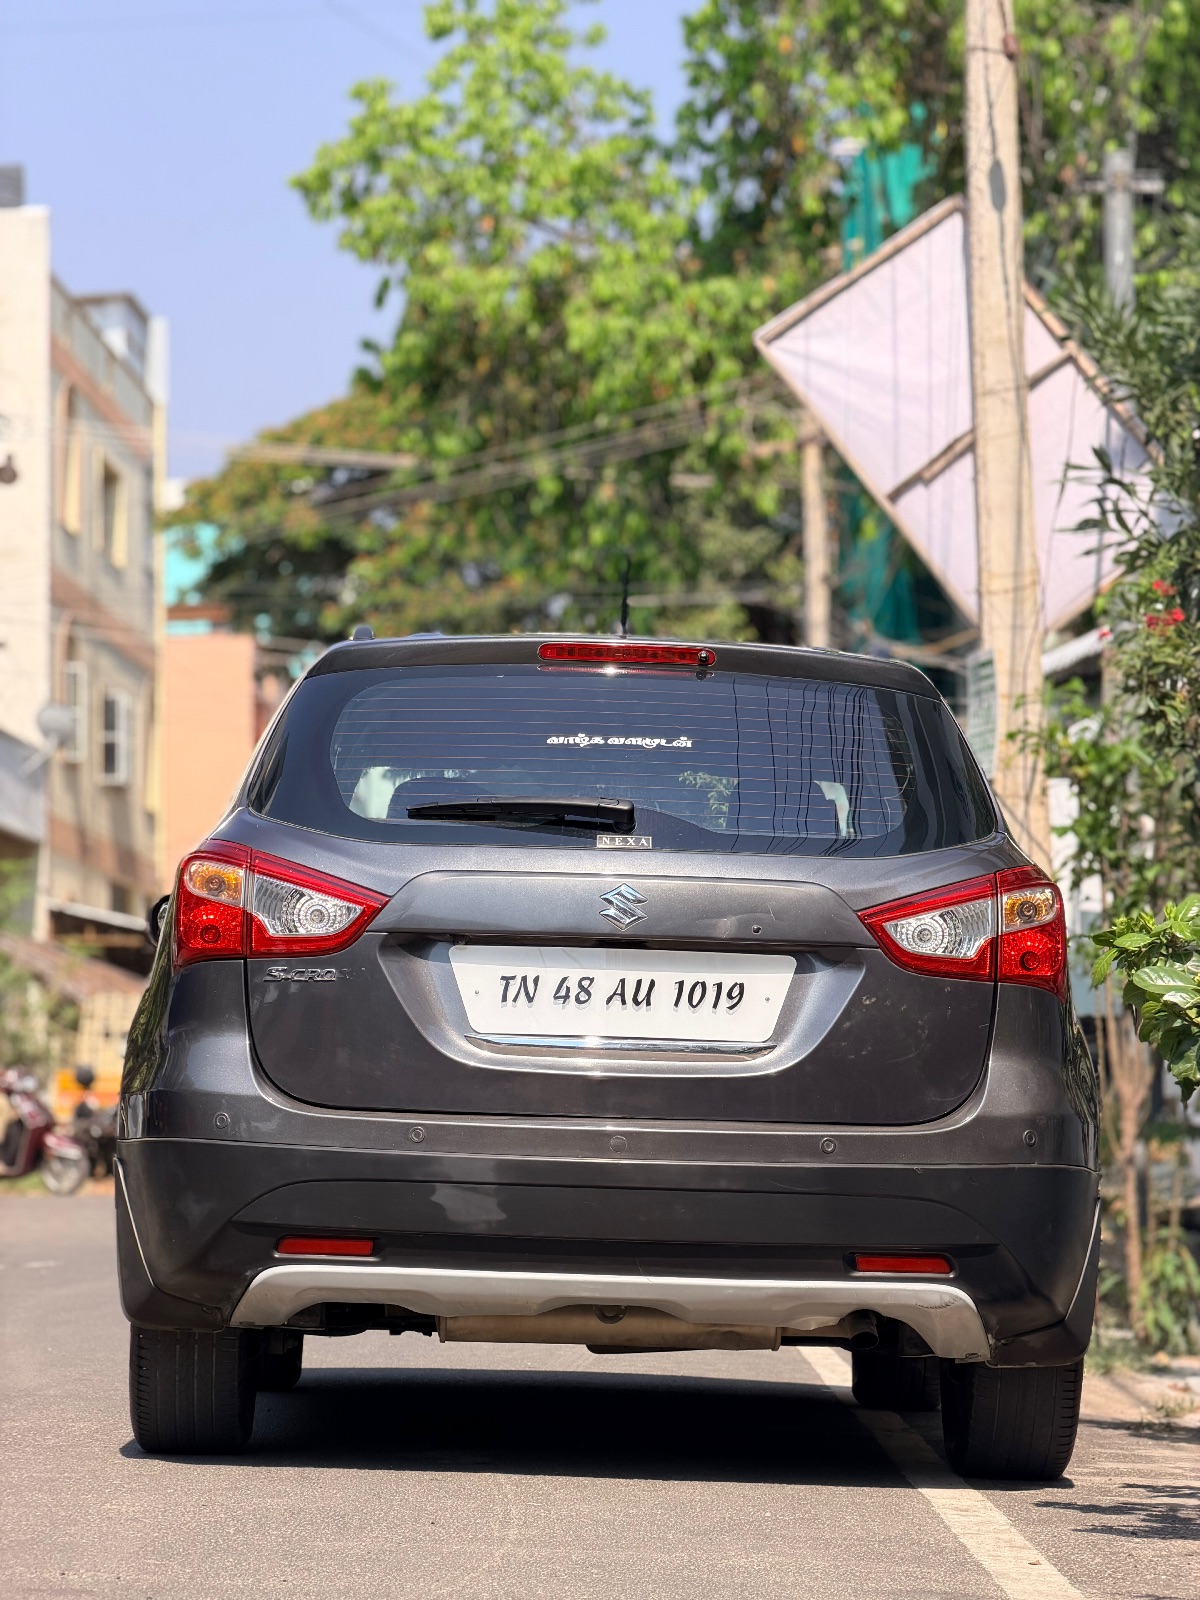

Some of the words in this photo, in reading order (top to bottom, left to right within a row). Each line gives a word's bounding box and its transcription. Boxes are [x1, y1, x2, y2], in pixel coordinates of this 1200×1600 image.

[546, 733, 604, 748] வாழ்க
[607, 736, 693, 749] வளமுடன்
[602, 836, 649, 847] NEXA
[500, 974, 540, 1004] TN
[553, 976, 595, 1006] 48
[605, 977, 656, 1008] AU
[673, 979, 745, 1012] 1019
